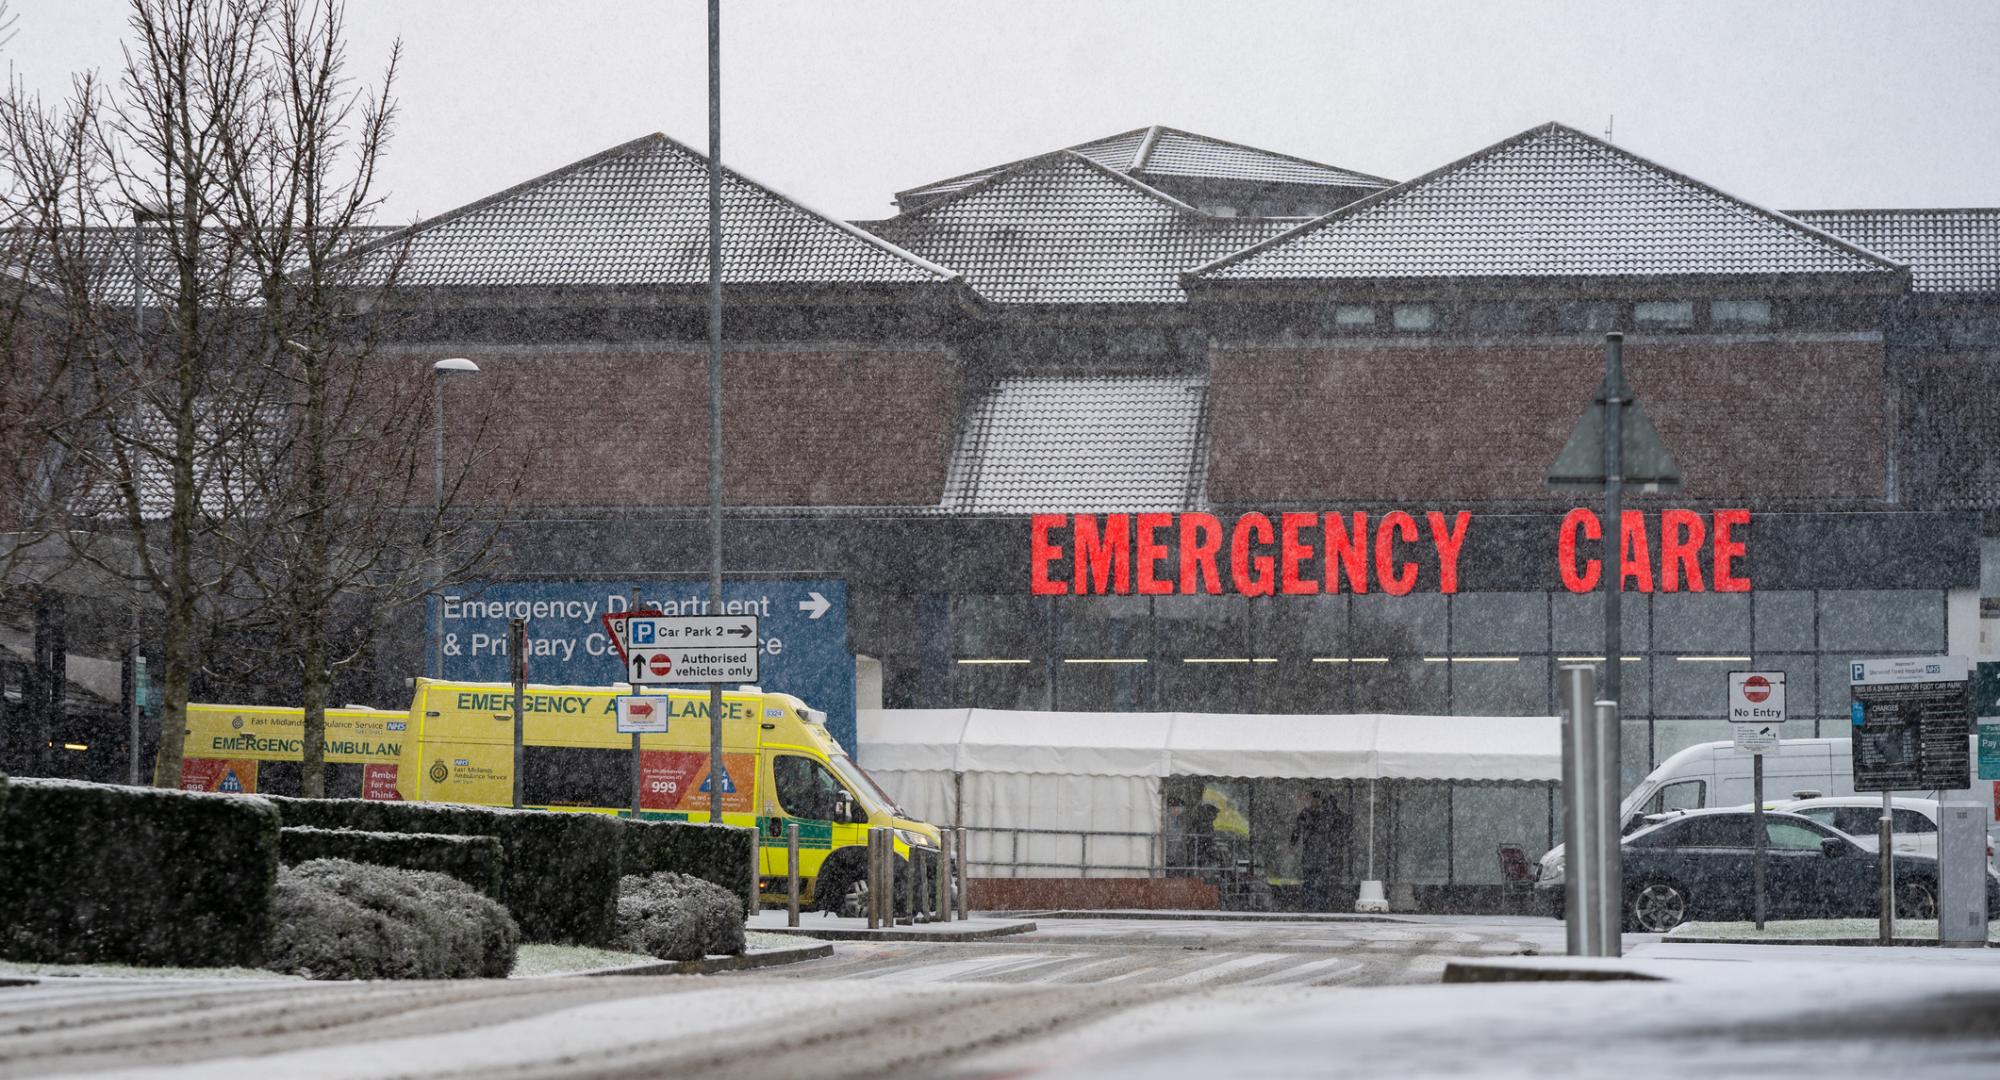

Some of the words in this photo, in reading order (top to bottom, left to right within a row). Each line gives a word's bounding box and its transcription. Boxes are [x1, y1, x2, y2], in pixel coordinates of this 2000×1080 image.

[1031, 511, 1472, 597] EMERGENCY
[1558, 507, 1750, 593] CARE
[444, 595, 598, 624] Emergency
[608, 595, 770, 617] Dartent
[658, 627, 680, 637] Car
[685, 626, 712, 637] Park
[716, 626, 724, 637] 2
[443, 633, 463, 656] &
[471, 633, 577, 662] Priary
[681, 653, 747, 664] Authorised
[675, 666, 724, 677] vehicles
[728, 666, 753, 678] only
[457, 693, 592, 714] EMERGENCY
[602, 698, 743, 720] ALANCE
[1734, 708, 1749, 717] No
[1753, 708, 1781, 718] Entry
[387, 722, 406, 730] NHS
[322, 741, 402, 756] AMBULAN
[1982, 739, 1997, 749] Pay
[651, 781, 677, 793] 999
[370, 790, 395, 799] Think
